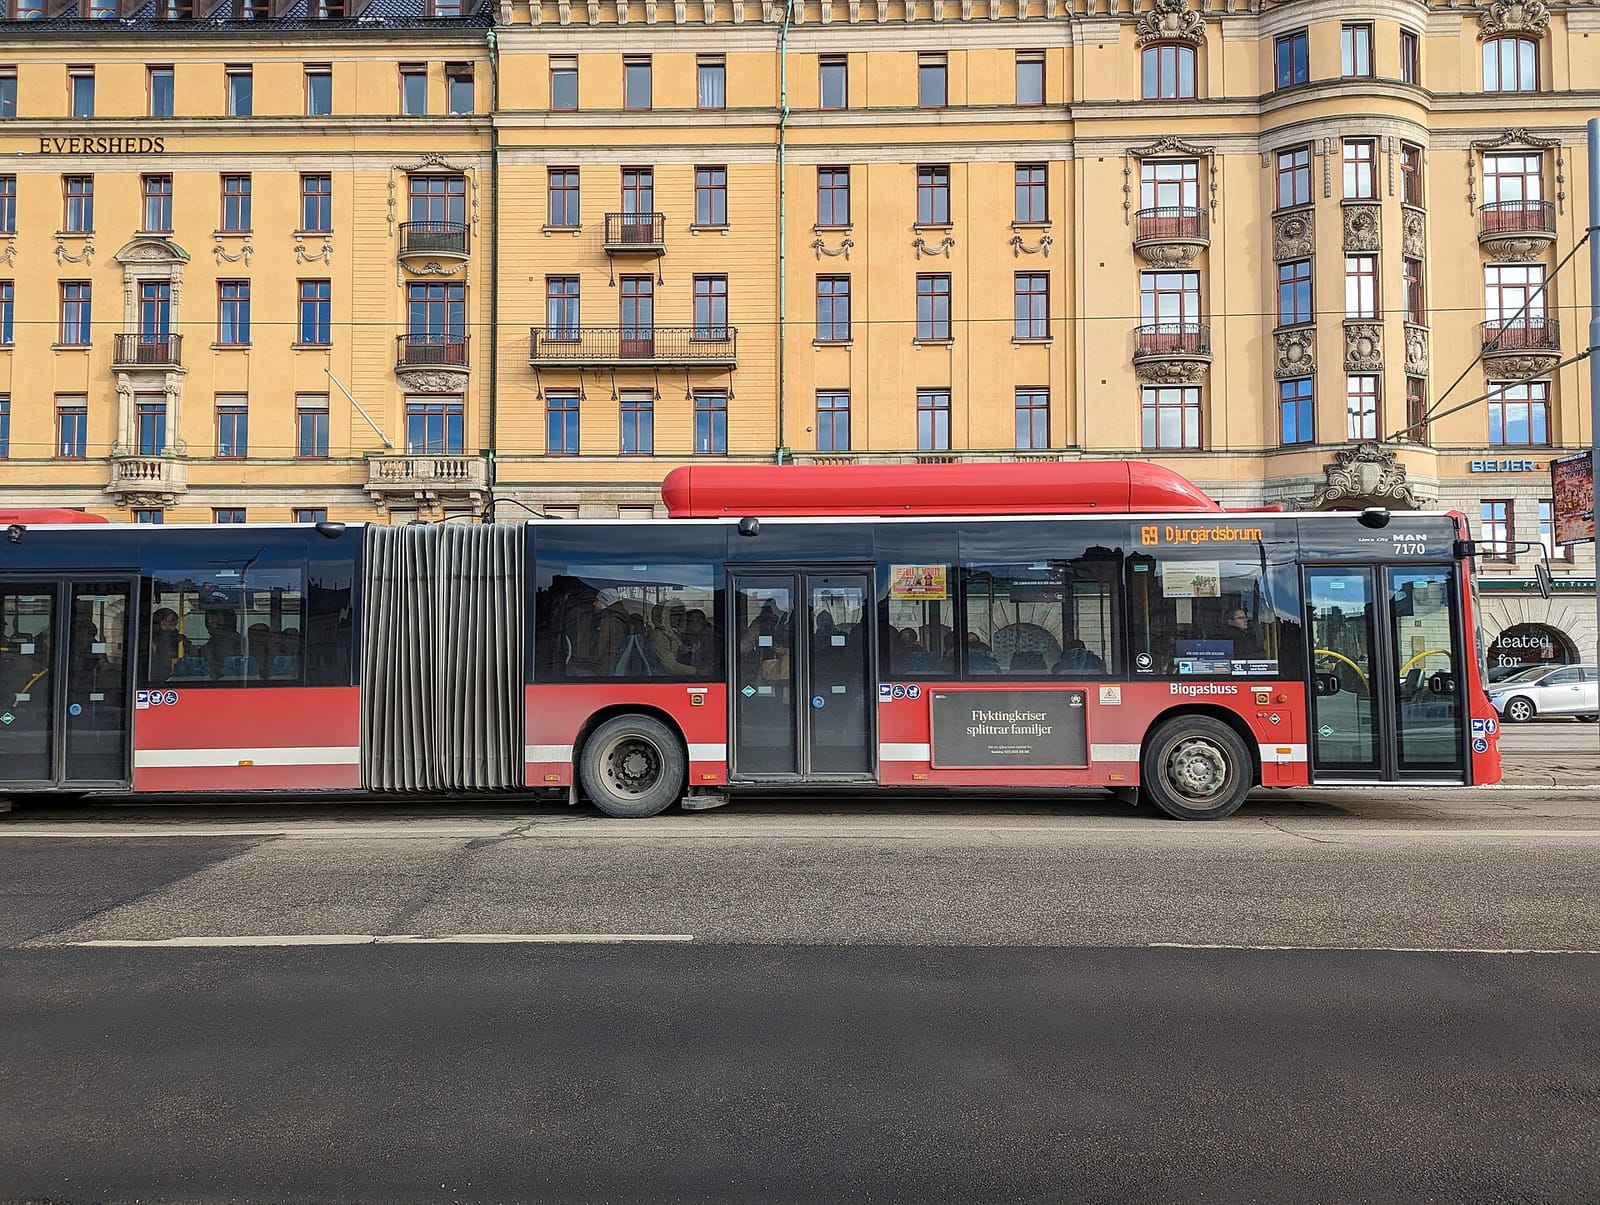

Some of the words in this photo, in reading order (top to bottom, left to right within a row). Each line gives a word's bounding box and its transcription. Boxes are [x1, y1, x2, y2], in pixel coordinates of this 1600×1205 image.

[39, 137, 165, 154] EVERSHEDS
[1471, 460, 1535, 473] BEIJER
[1141, 526, 1159, 545] 69
[1165, 525, 1263, 545] Djurgårdsbrunn
[1392, 534, 1428, 542] MAN
[1393, 543, 1426, 555] 7170
[1496, 635, 1550, 648] leated
[1497, 654, 1522, 668] for
[1233, 664, 1244, 672] SL
[1170, 683, 1238, 697] Biogasbuss
[971, 710, 1047, 723] Flyktingkriser
[966, 724, 1009, 737] splittrar
[1010, 724, 1053, 737] familjer
